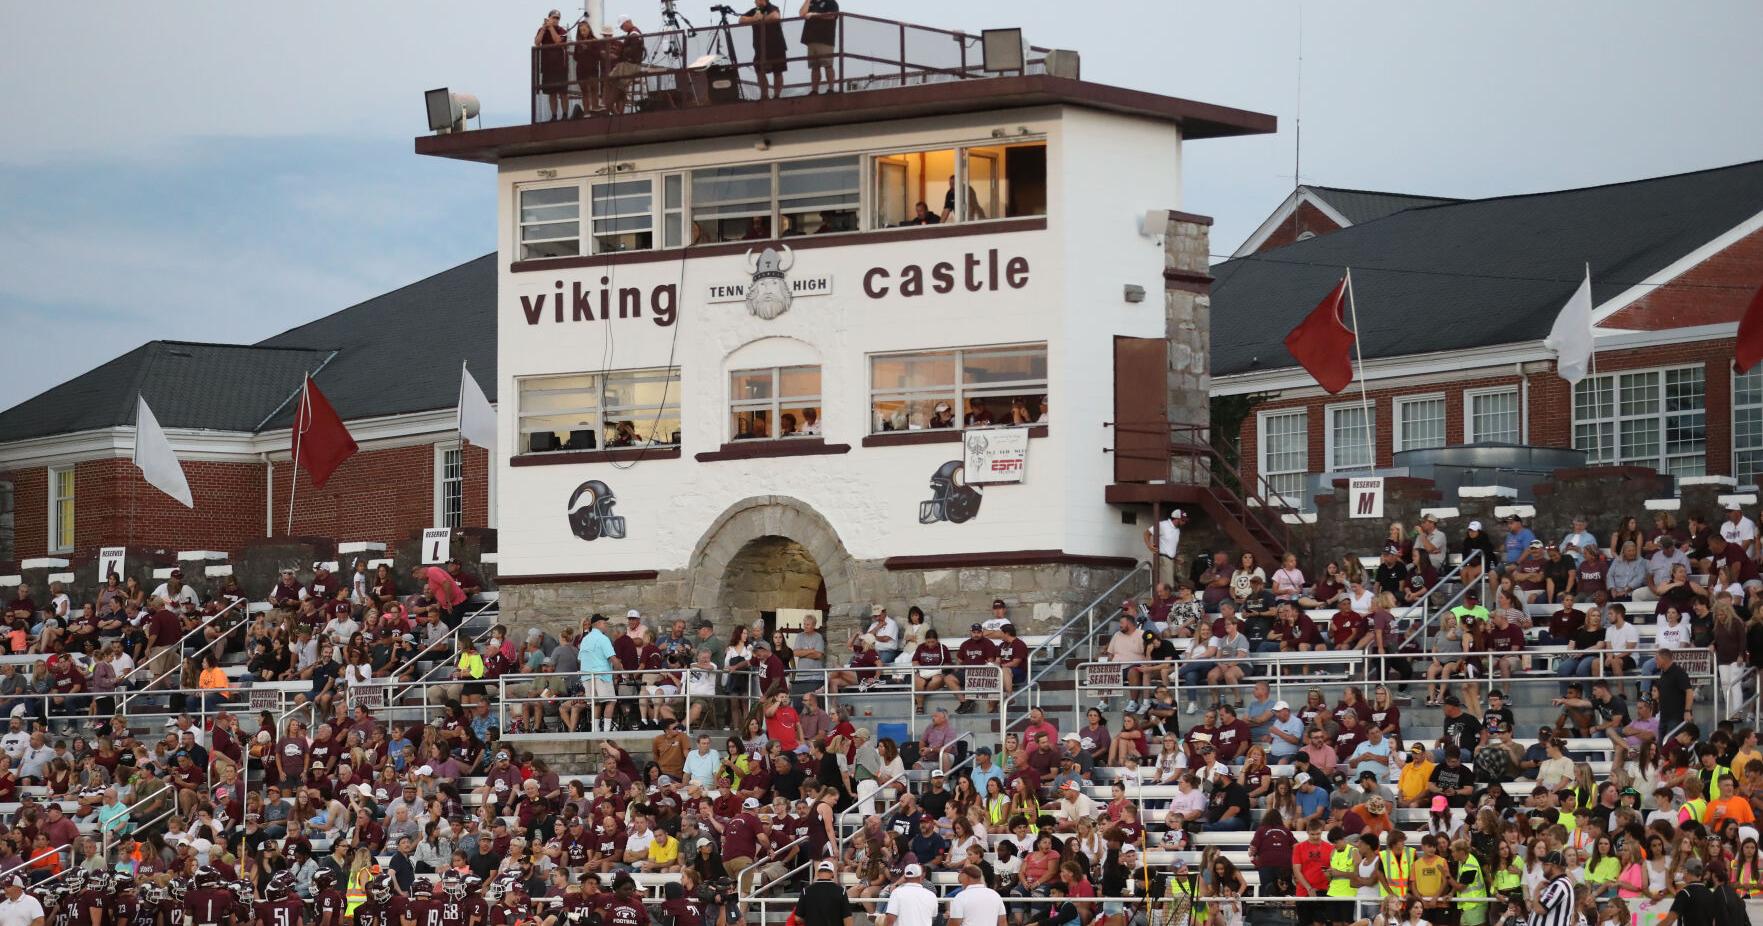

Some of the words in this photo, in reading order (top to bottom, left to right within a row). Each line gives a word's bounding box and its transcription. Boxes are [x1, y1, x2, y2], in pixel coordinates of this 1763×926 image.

[863, 248, 1030, 299] castle
[709, 285, 744, 298] TENN
[793, 279, 827, 291] HIGH
[520, 276, 677, 327] viking
[991, 459, 1023, 471] ESPN
[1352, 480, 1381, 489] RESERVED
[1357, 492, 1375, 515] M
[425, 530, 449, 538] RESERVED
[432, 541, 440, 561] L
[967, 667, 999, 677] RESERVED
[1088, 664, 1121, 673] RESERVED
[968, 677, 998, 688] SEATING
[1090, 674, 1121, 685] SEATING
[251, 699, 277, 709] SEATING
[67, 902, 79, 919] 74
[171, 909, 182, 925] 12
[207, 898, 213, 922] 1
[274, 907, 289, 926] 51
[443, 903, 459, 920] 68
[474, 904, 480, 914] 2
[427, 909, 439, 926] 19
